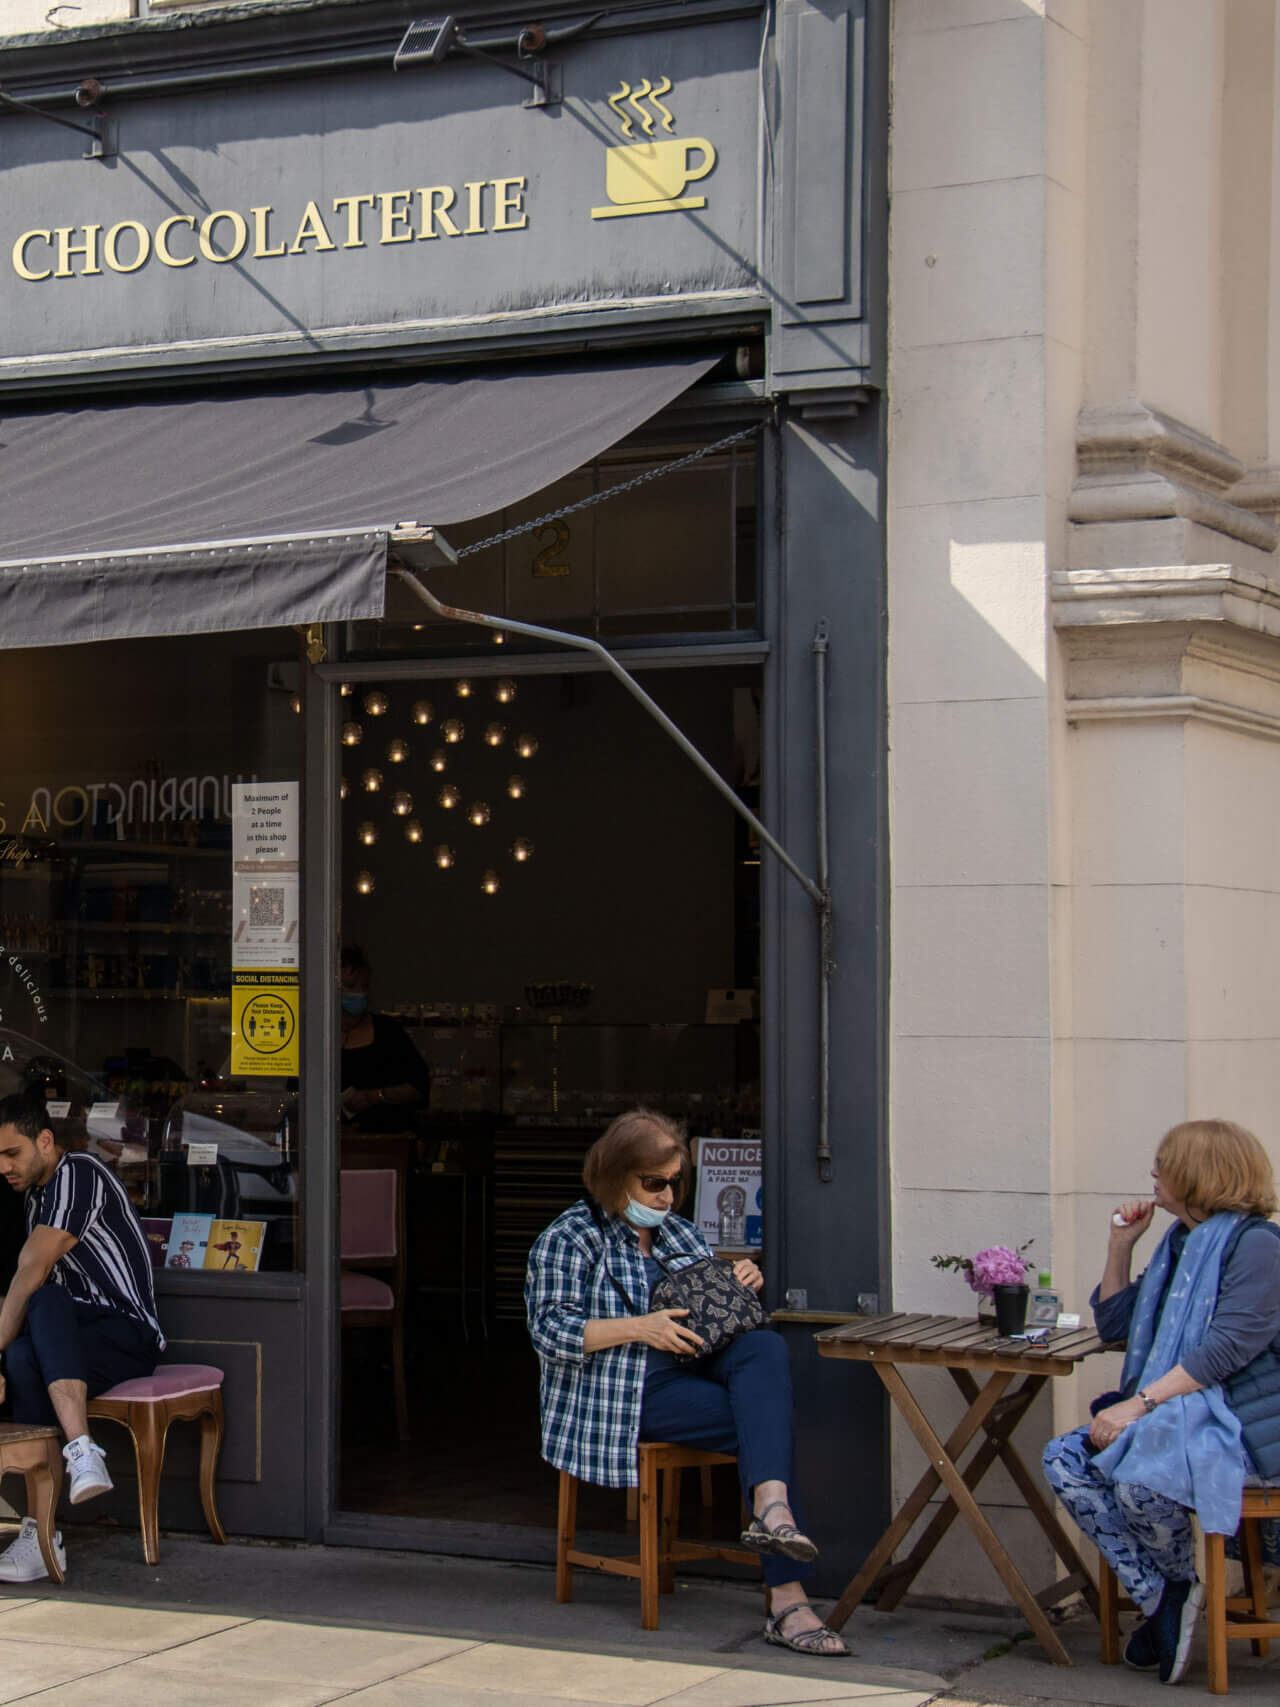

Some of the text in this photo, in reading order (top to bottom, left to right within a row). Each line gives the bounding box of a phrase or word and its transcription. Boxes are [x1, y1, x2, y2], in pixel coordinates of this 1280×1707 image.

[12, 176, 529, 281] CHOCOLATERIE
[532, 516, 570, 577] 2
[244, 793, 289, 802] Maximum of
[251, 807, 282, 816] 2 People
[266, 820, 282, 828] time
[255, 833, 268, 841] this
[270, 833, 287, 842] shop
[255, 846, 279, 855] please
[235, 975, 258, 983] SOCIAL
[8, 955, 48, 1023] delicious
[704, 1147, 762, 1163] NOTICE
